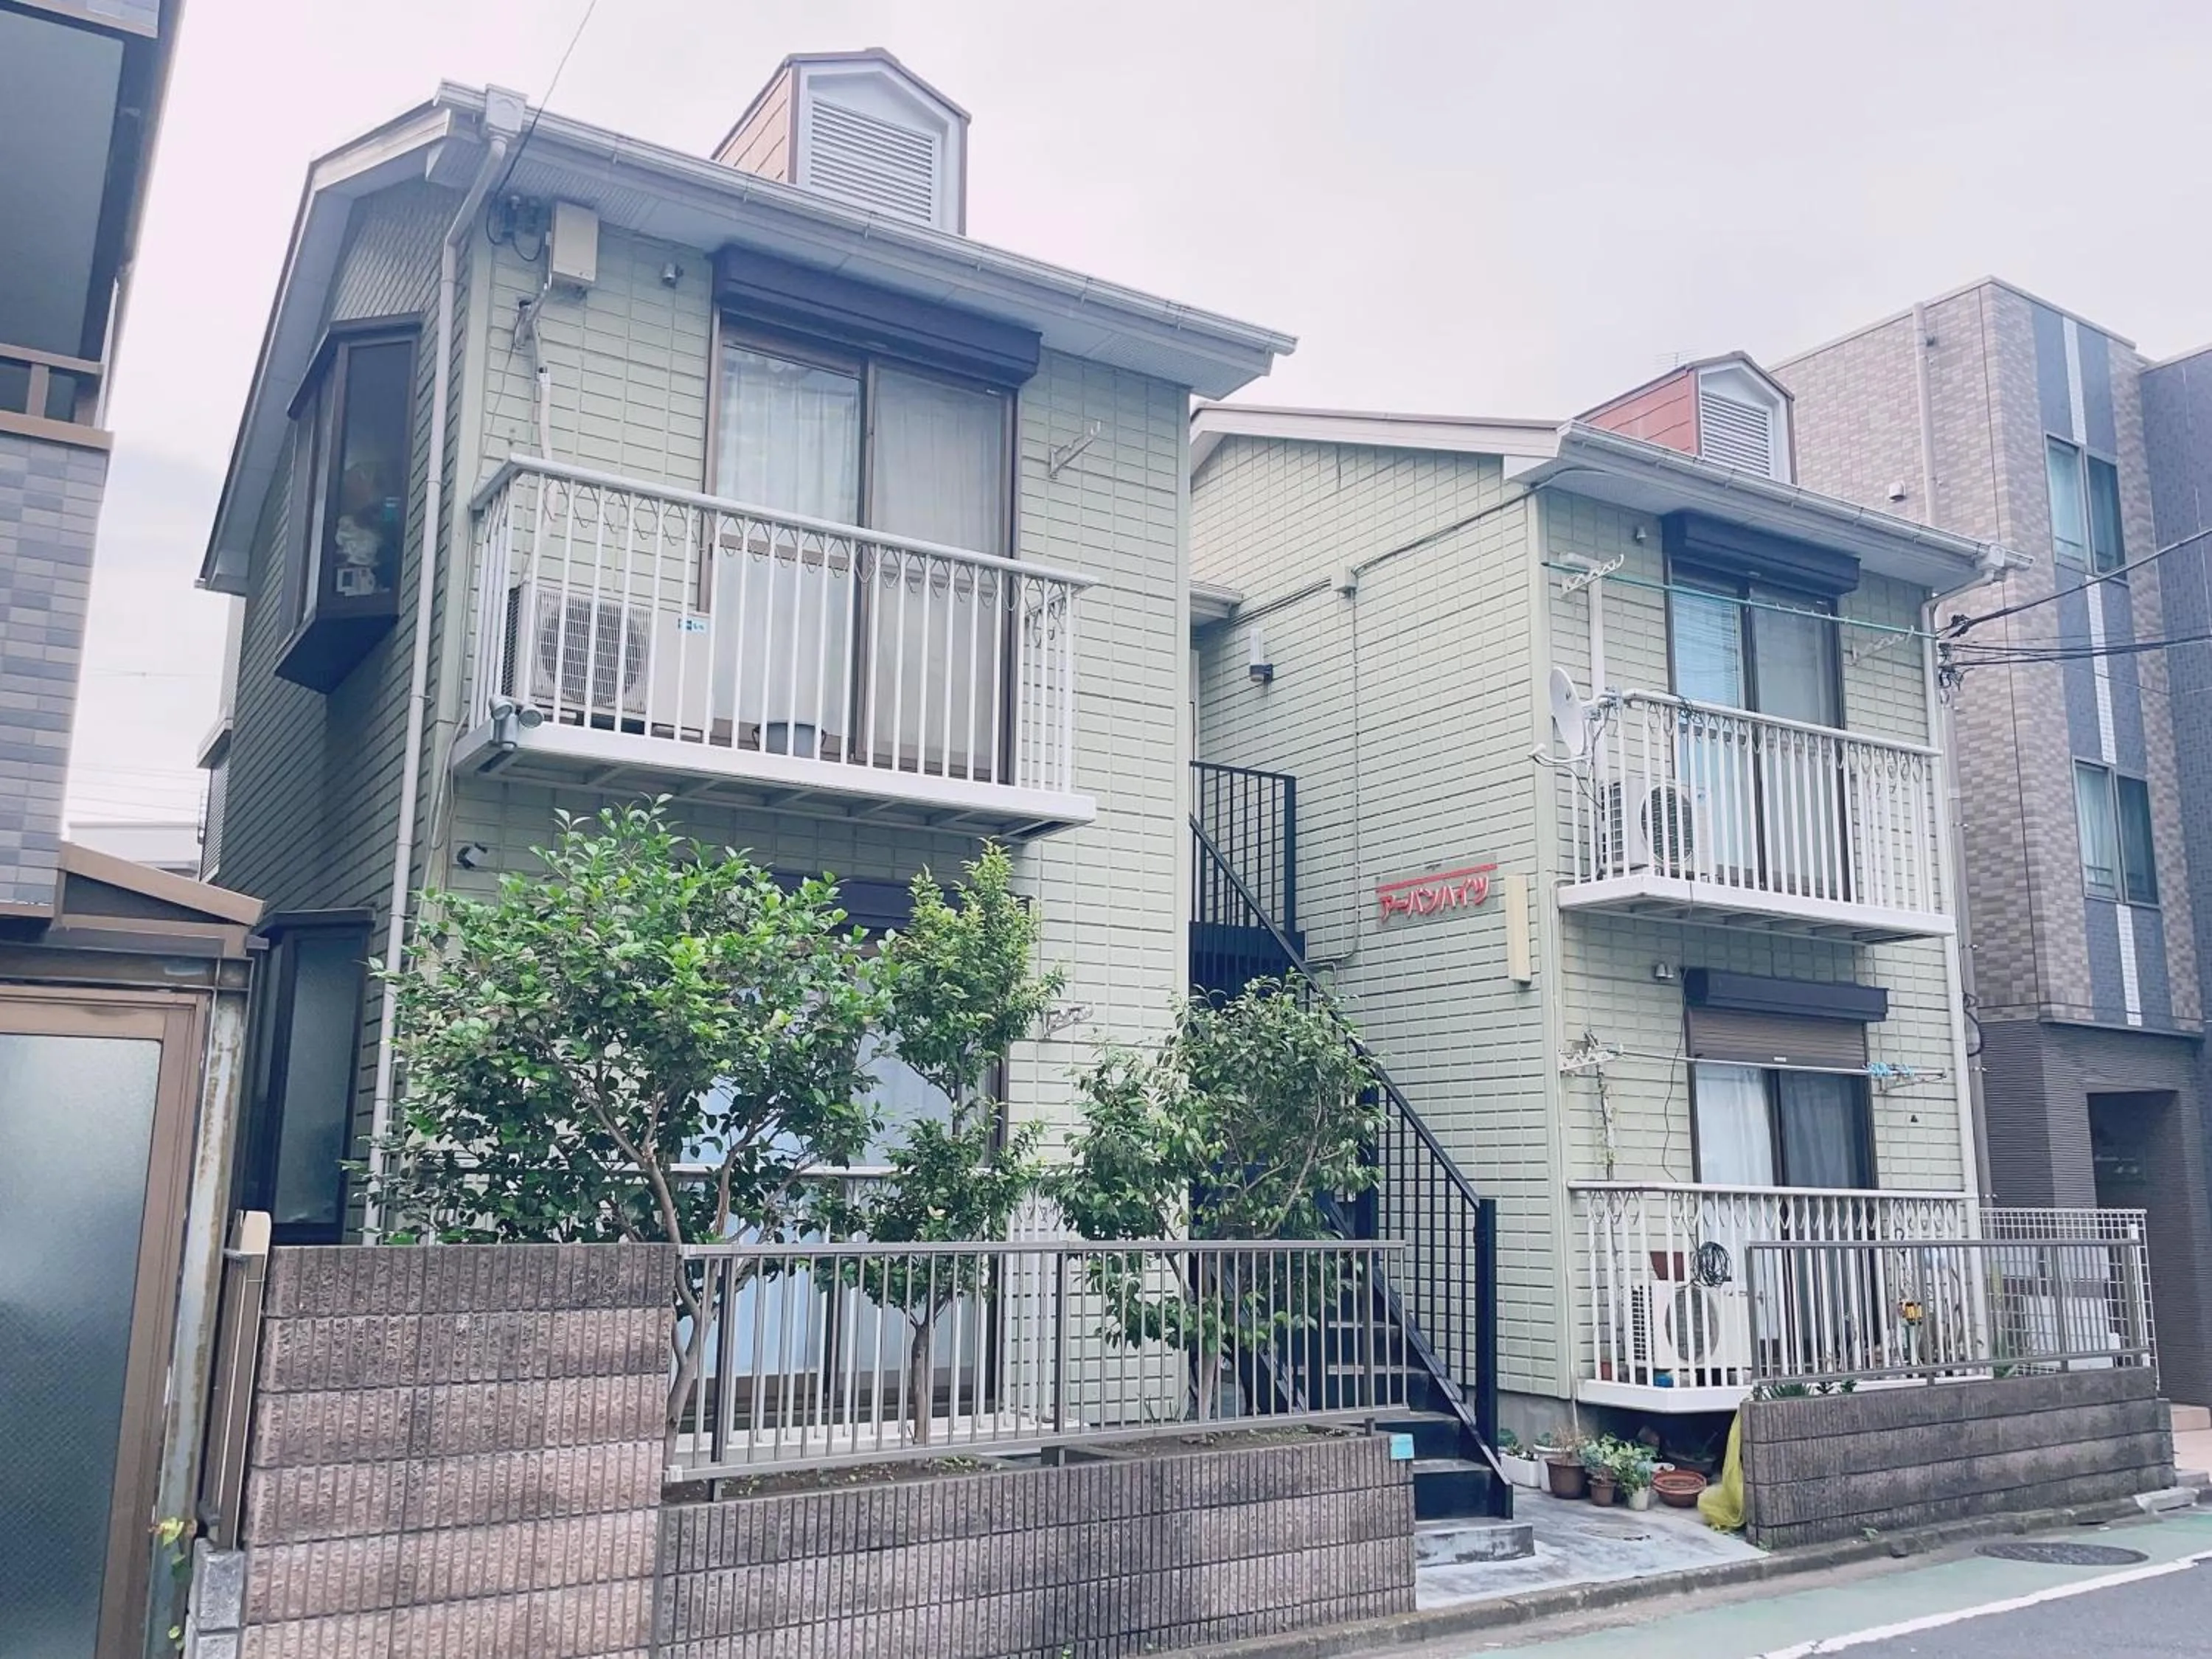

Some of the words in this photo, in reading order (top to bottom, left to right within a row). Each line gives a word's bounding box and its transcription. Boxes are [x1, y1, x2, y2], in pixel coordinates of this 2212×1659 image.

[1380, 876, 1489, 922] アーバンハイツ
